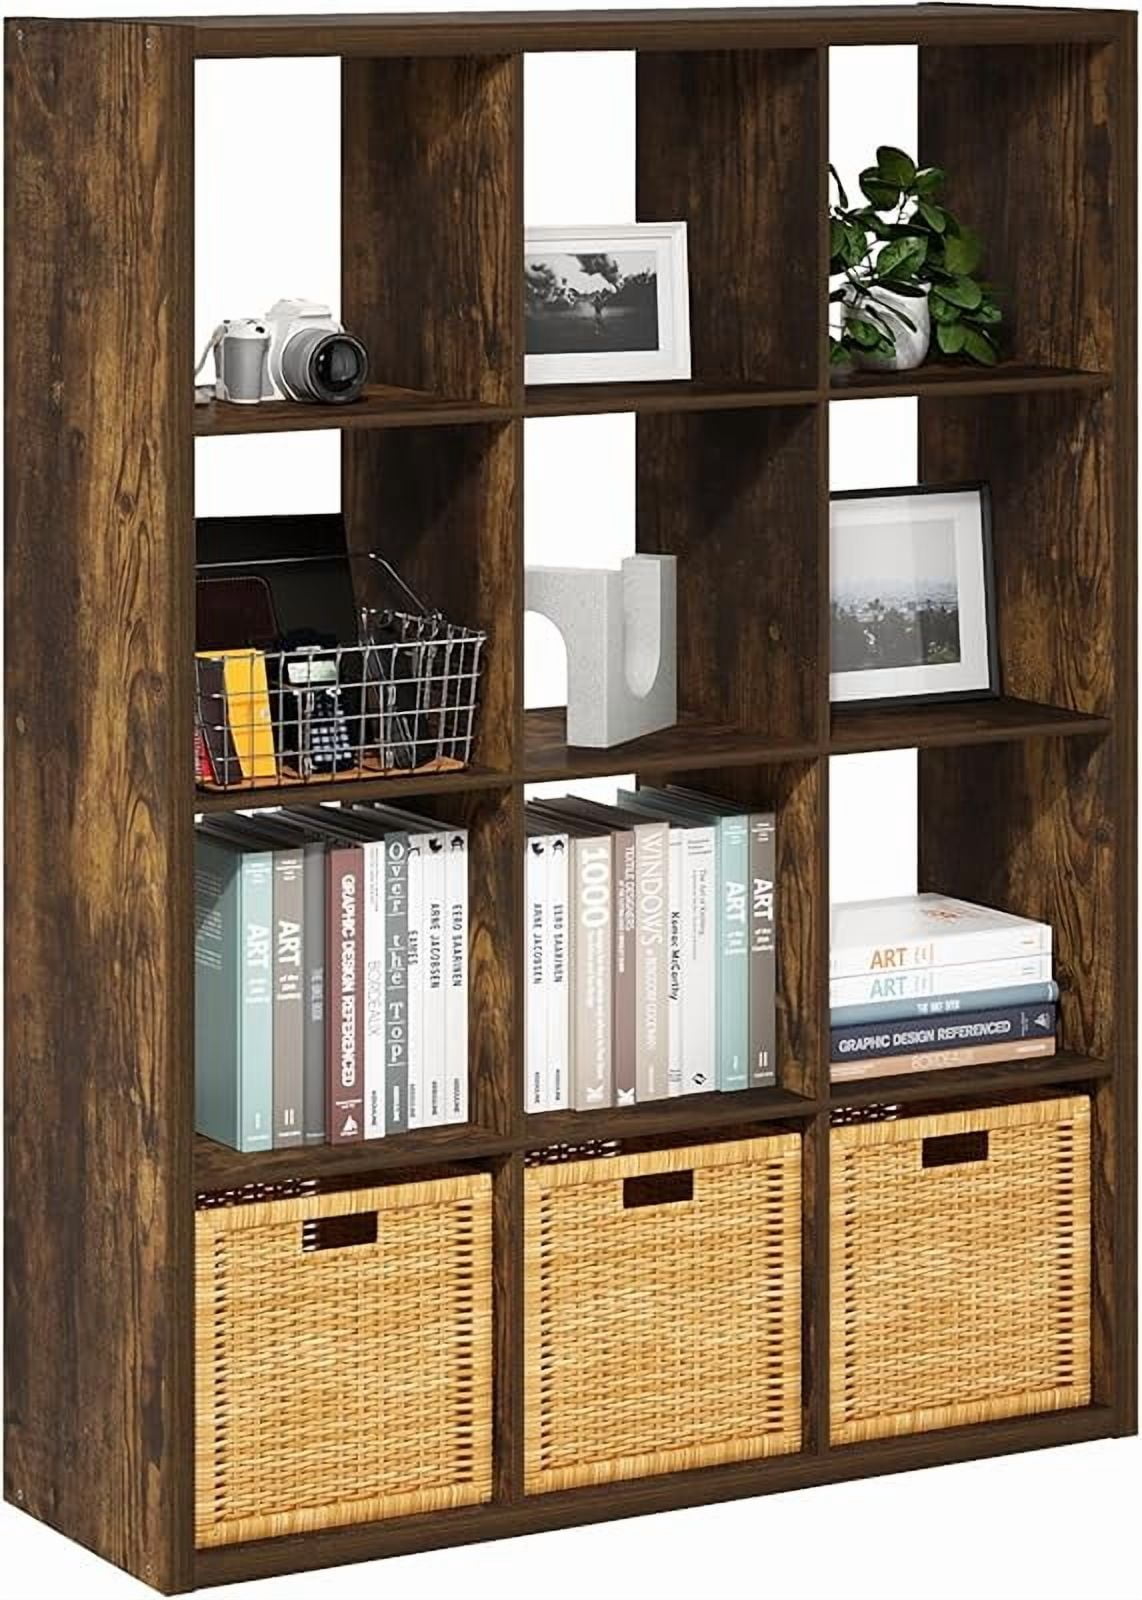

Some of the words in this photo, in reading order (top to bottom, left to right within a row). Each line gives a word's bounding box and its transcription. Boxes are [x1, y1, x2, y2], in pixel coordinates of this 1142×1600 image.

[389, 841, 404, 913] Over
[581, 846, 609, 928] 1000
[640, 832, 663, 945] WINDOWS
[726, 881, 745, 922] ART
[754, 878, 773, 920] ART
[341, 874, 356, 938] GRAPHIC
[430, 903, 440, 930] ARNE
[452, 904, 462, 931] EERO
[533, 903, 542, 928] ARNE
[553, 904, 563, 930] EERO
[247, 924, 270, 970] ART
[278, 920, 301, 967] ART
[341, 941, 356, 992] DESIGN
[430, 935, 440, 988] JACOBSEN
[452, 935, 462, 987] SAARINEN
[533, 933, 542, 984] JACOBSEN
[553, 933, 563, 983] SAARINEN
[870, 947, 907, 969] ART
[368, 961, 383, 1037] BORDEAUX
[870, 976, 907, 998] ART
[341, 995, 356, 1087] REFERENCED
[390, 1002, 404, 1063] Top
[838, 1034, 890, 1053] GRAPHIC
[893, 1027, 935, 1047] DESIGN
[938, 1020, 1011, 1040] REFERENCED
